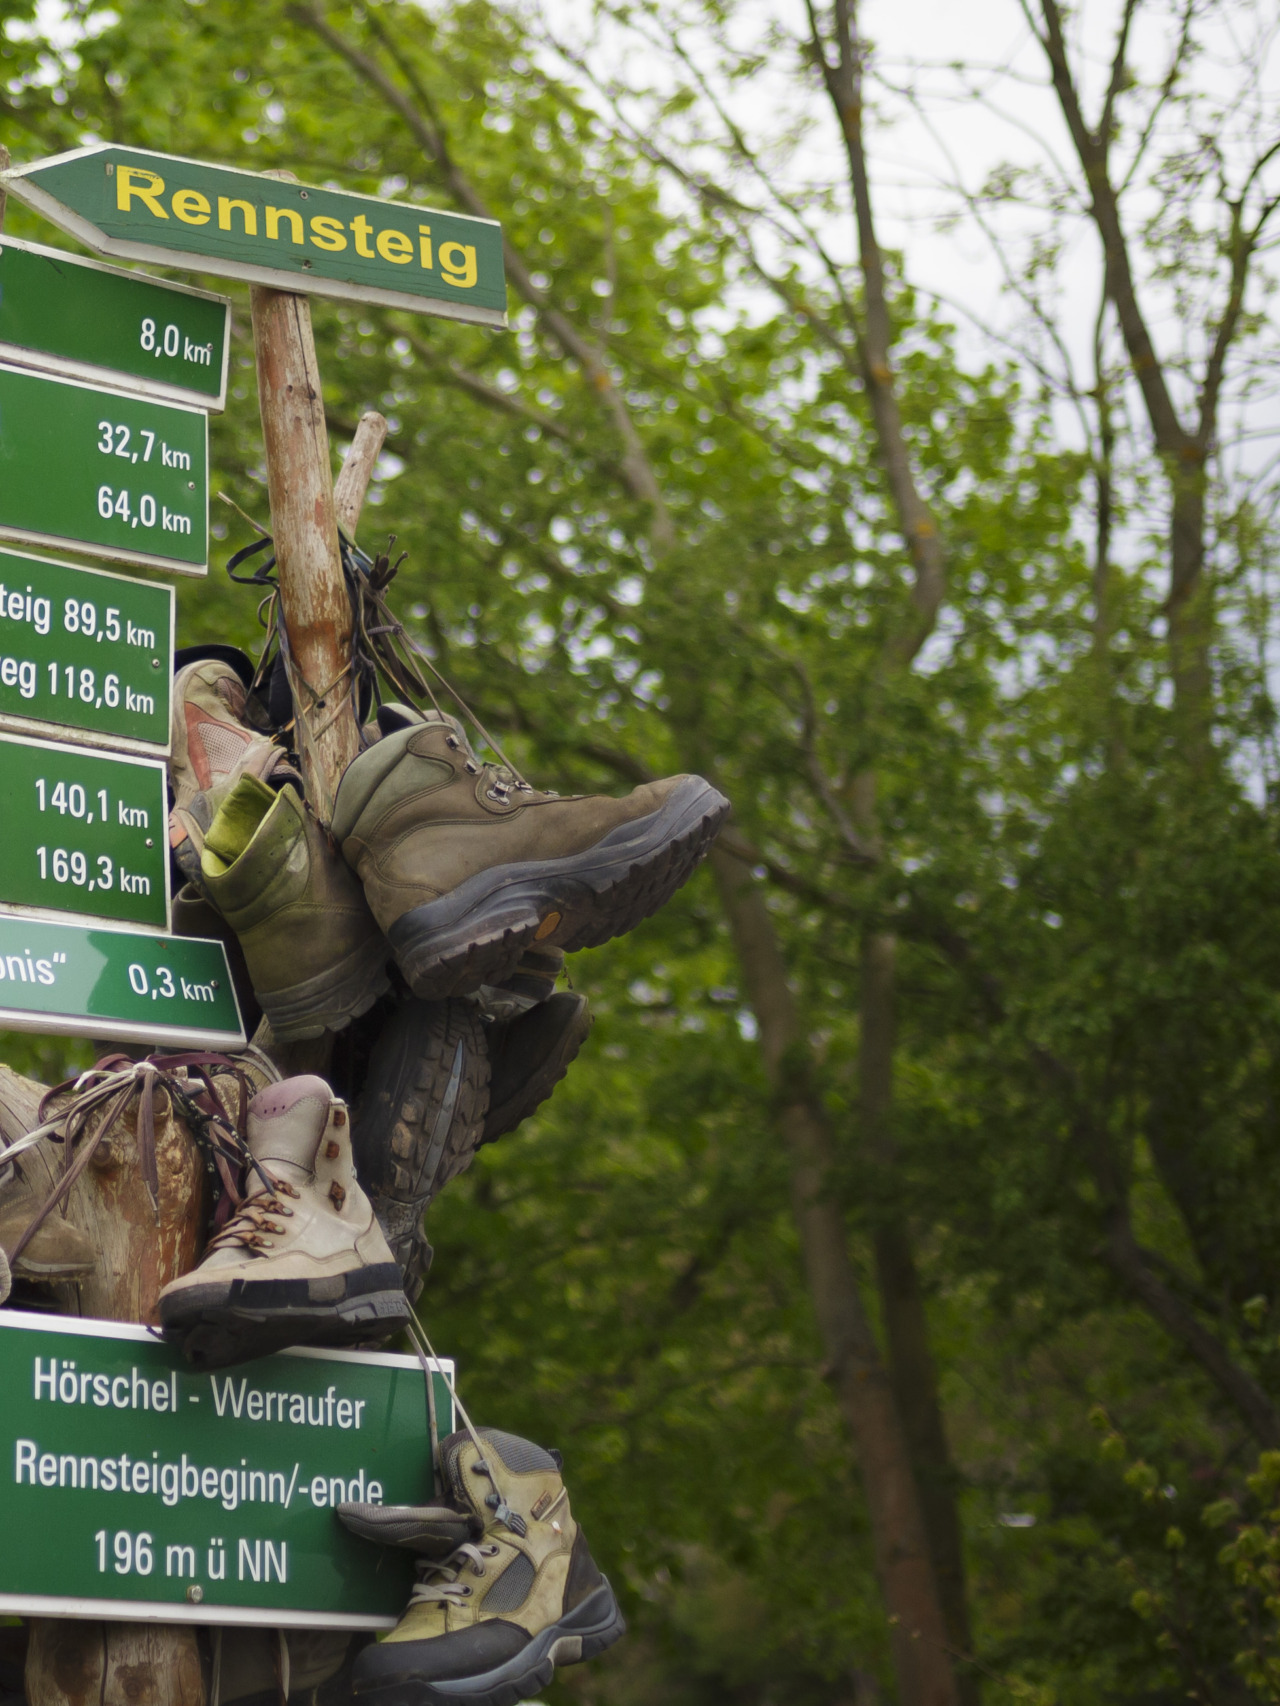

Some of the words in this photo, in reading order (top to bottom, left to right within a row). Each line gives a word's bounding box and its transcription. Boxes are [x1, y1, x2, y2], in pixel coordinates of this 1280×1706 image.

[116, 165, 478, 289] Rennsteig
[141, 319, 179, 357] 8,0
[184, 337, 211, 365] km
[98, 422, 154, 463] 32,7
[162, 443, 190, 470] km
[99, 486, 155, 528] 64,0
[163, 507, 190, 534] km
[64, 599, 120, 642] 89,5
[127, 620, 154, 648] km
[48, 663, 119, 708] 118,6
[126, 686, 153, 714] km
[36, 779, 107, 823] 140,1
[119, 800, 148, 828] km
[37, 847, 112, 891] 169,3
[121, 867, 149, 895] km
[129, 964, 175, 999] 0,3
[181, 978, 214, 1001] km
[35, 1357, 176, 1411] Hörschel
[211, 1376, 365, 1429] Werraufer
[15, 1440, 384, 1511] Rennsteigbeginn/-ende
[95, 1531, 152, 1575] 196
[167, 1546, 194, 1577] m
[208, 1538, 224, 1579] ü
[239, 1539, 286, 1583] NN
